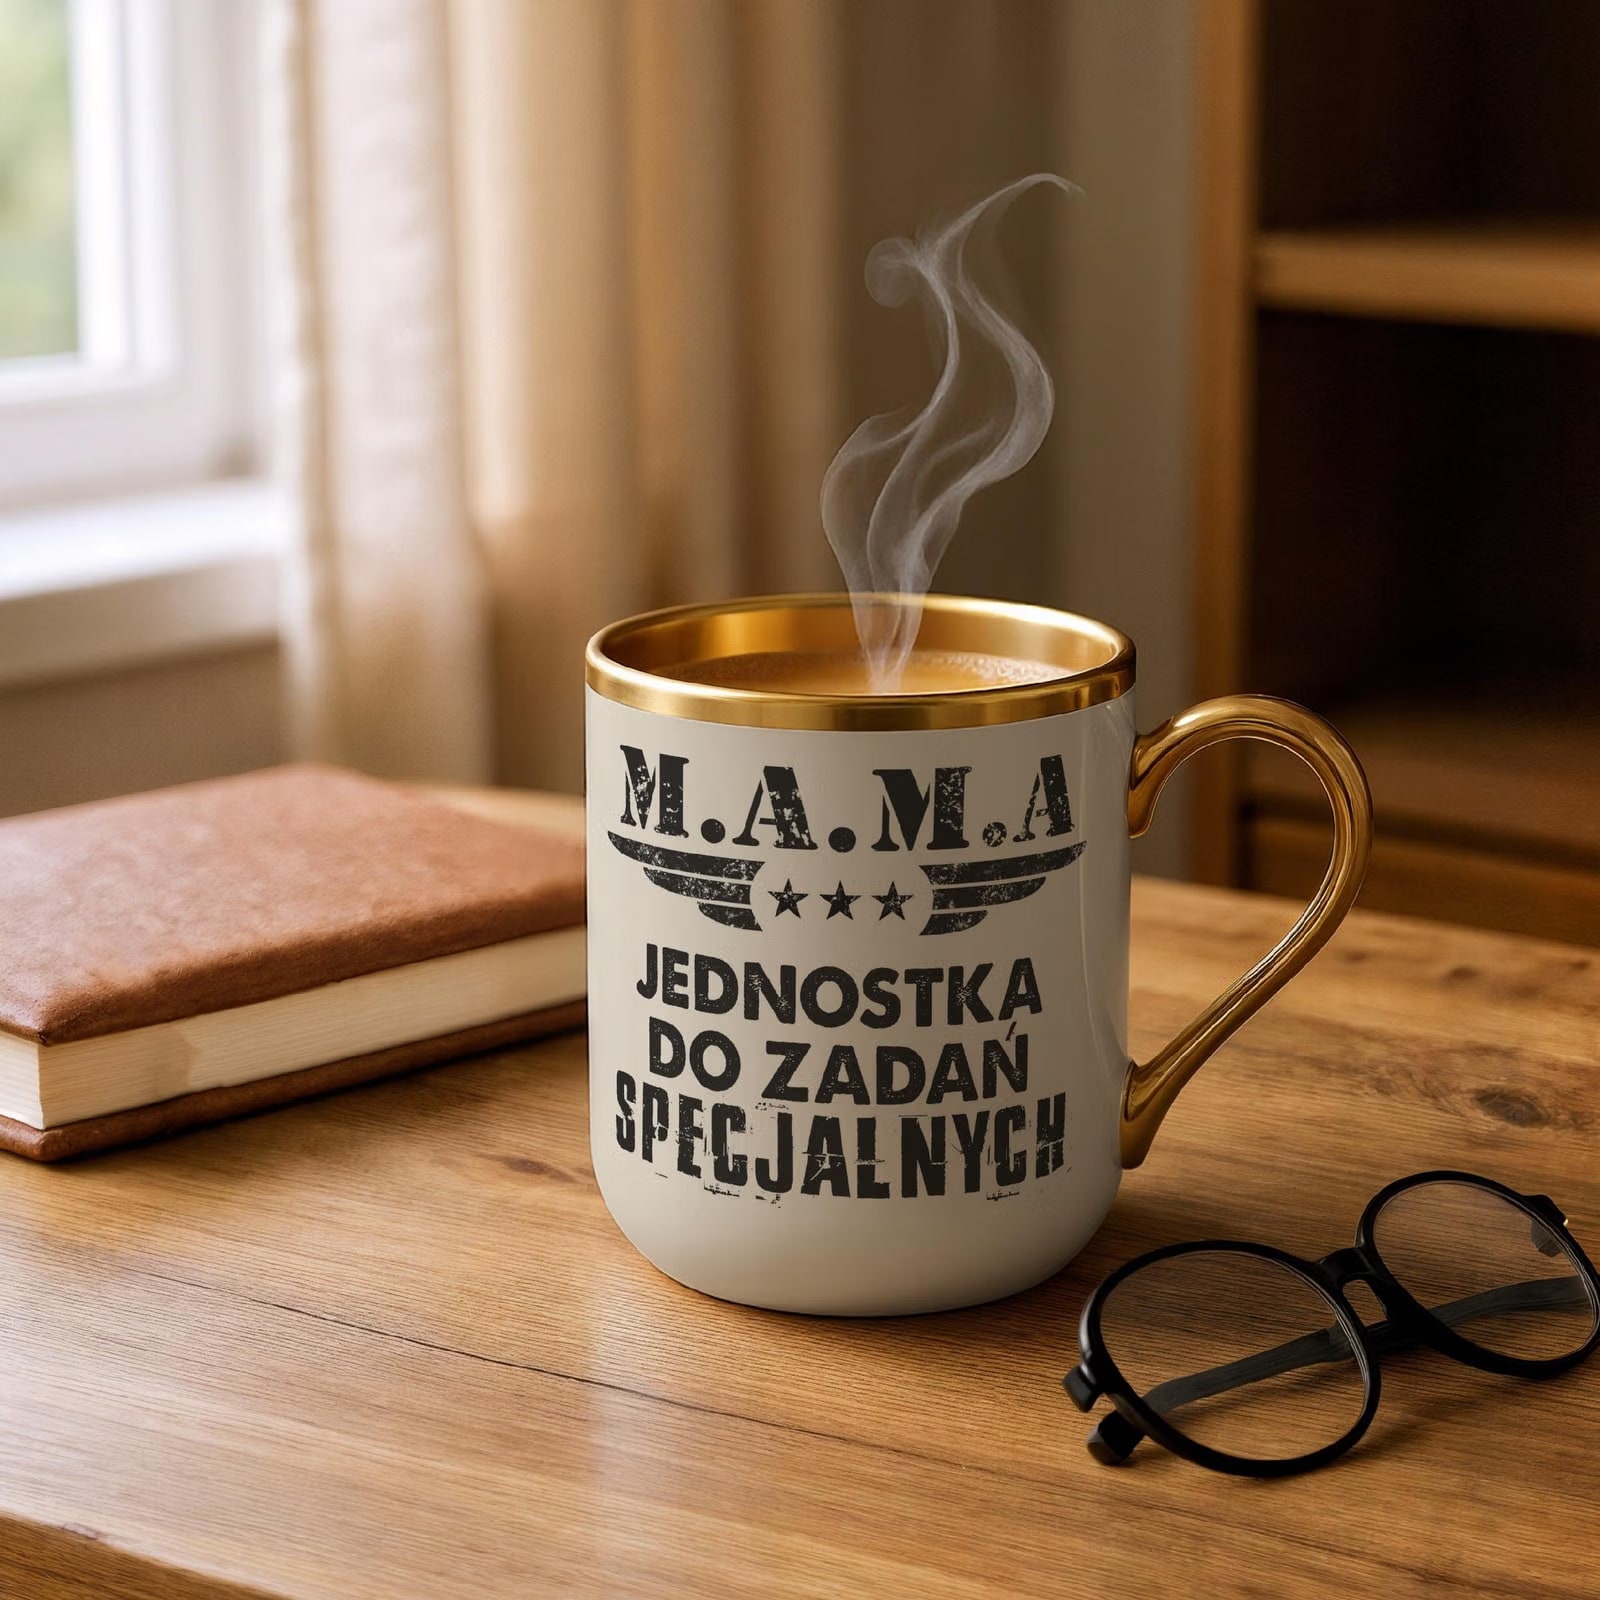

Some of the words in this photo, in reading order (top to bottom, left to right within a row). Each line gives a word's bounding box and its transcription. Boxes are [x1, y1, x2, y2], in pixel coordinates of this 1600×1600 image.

[619, 744, 1076, 854] M.A.M.A
[636, 943, 1043, 1030] JEDNOSTKA
[649, 1016, 741, 1092] DO
[761, 1020, 1029, 1106] ZADAŃ
[615, 1070, 1067, 1200] SPECJALNYCH
